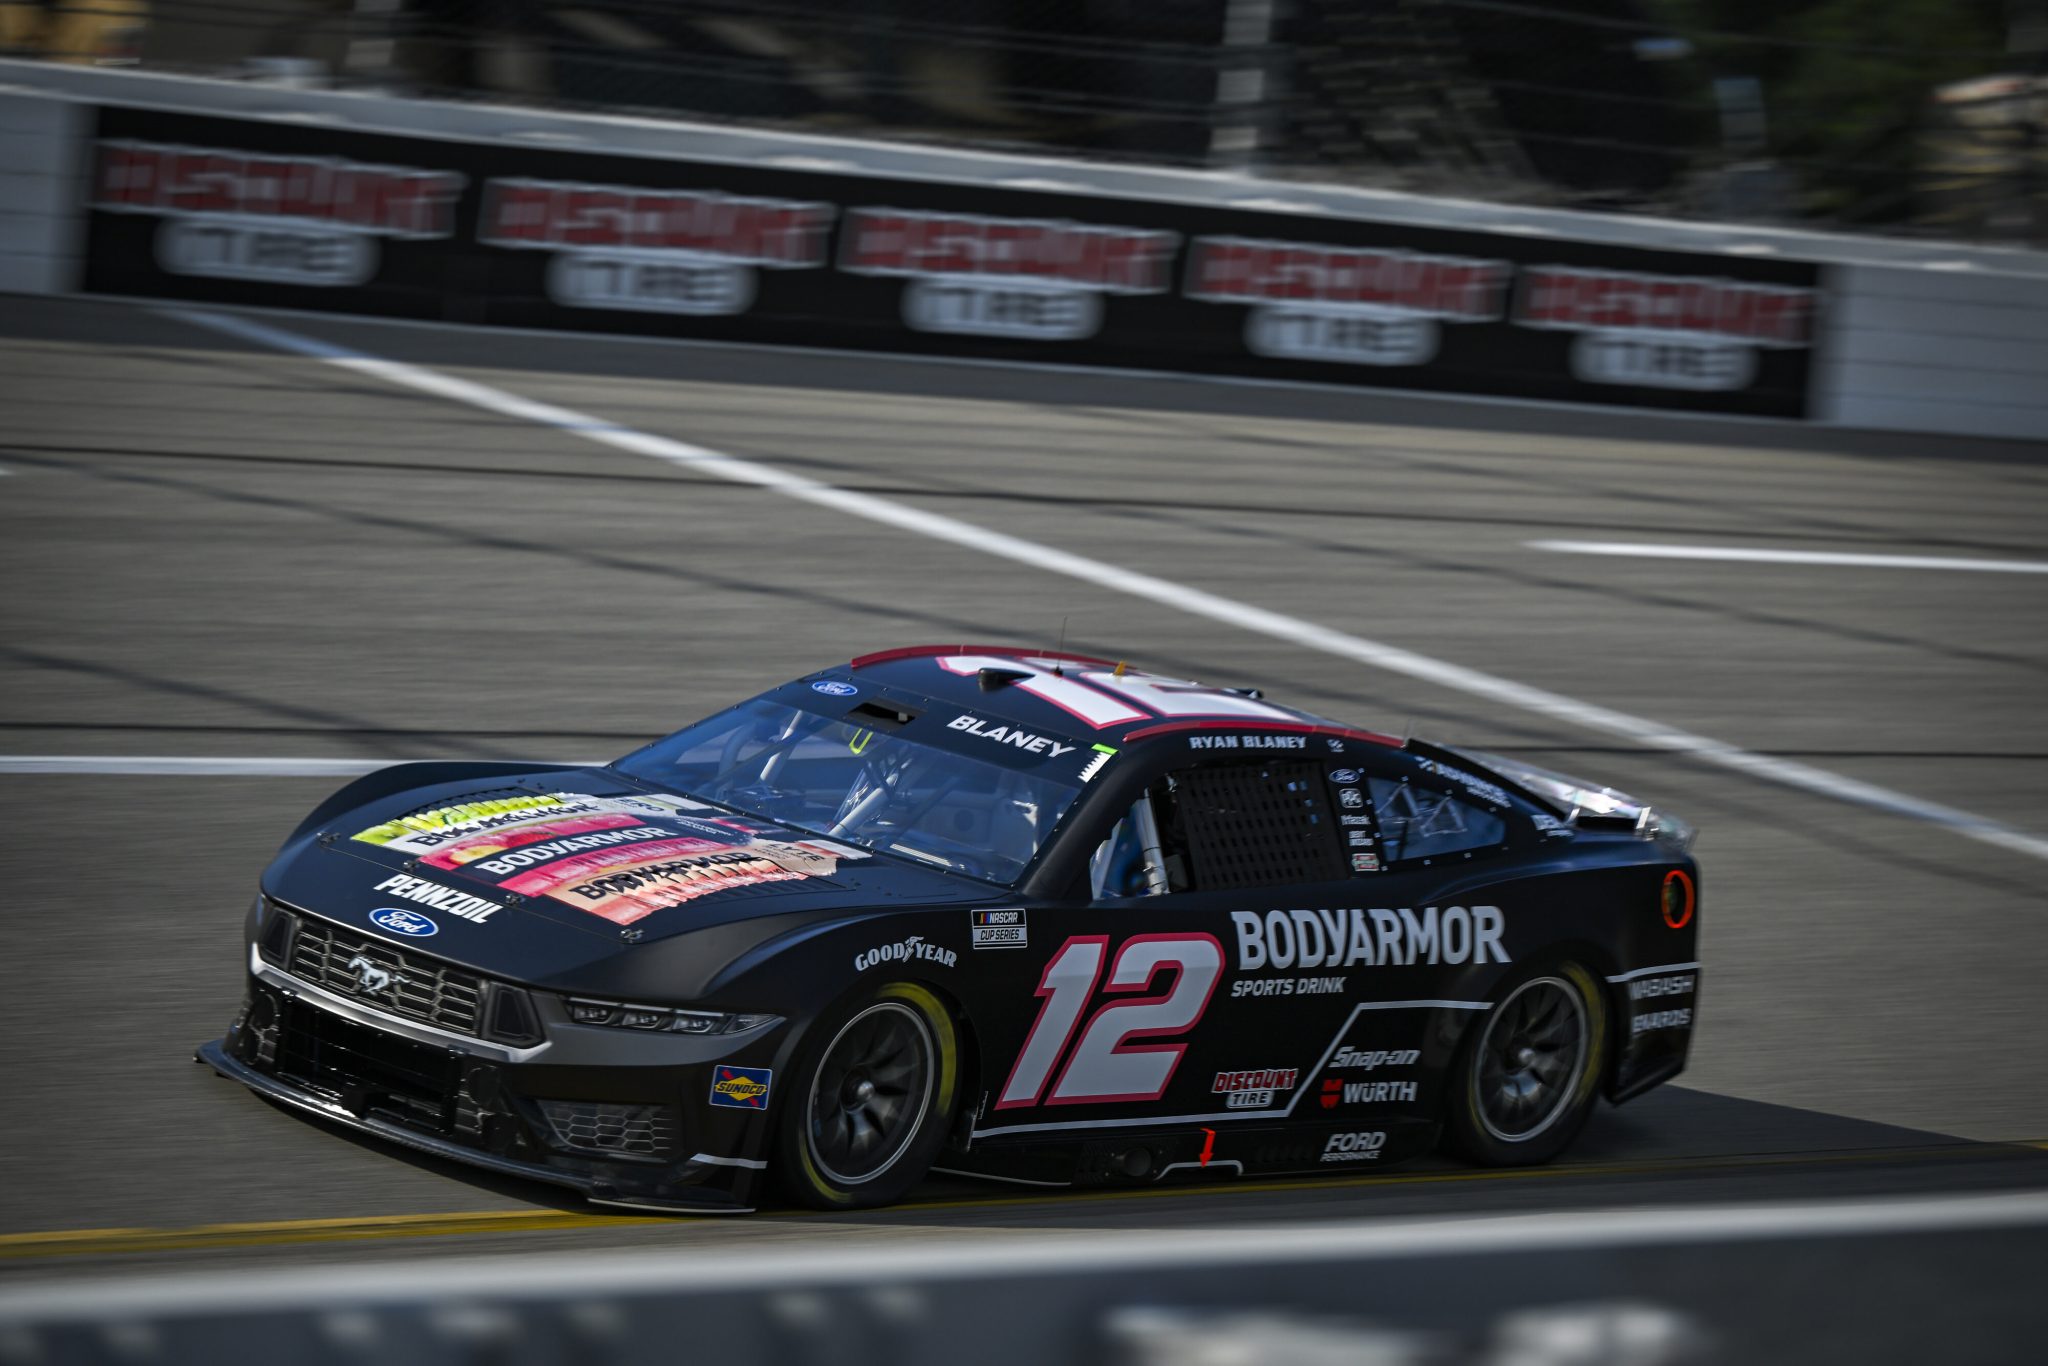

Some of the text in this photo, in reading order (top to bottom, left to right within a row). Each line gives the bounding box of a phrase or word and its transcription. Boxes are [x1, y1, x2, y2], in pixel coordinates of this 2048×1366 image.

[946, 714, 1077, 758] BLANEY
[1189, 735, 1307, 749] RYAN BLANEY
[475, 826, 679, 875] BODYARMOR
[373, 873, 503, 924] PENNZOIL
[378, 910, 429, 934] Ford
[988, 911, 1018, 924] NASCAR
[980, 928, 1020, 941] CUP SERIES
[1230, 905, 1513, 971] BODYARMOR
[1231, 976, 1347, 998] SPORTS DRINK
[994, 931, 1226, 1111] 12
[1329, 1046, 1421, 1071] Snap-on
[717, 1082, 766, 1095] SUNOCO
[1212, 1068, 1298, 1093] DISCOUNT
[1232, 1091, 1269, 1105] TIRE
[1325, 1131, 1387, 1152] FORD
[1320, 1150, 1382, 1163] PERFORMANCE
